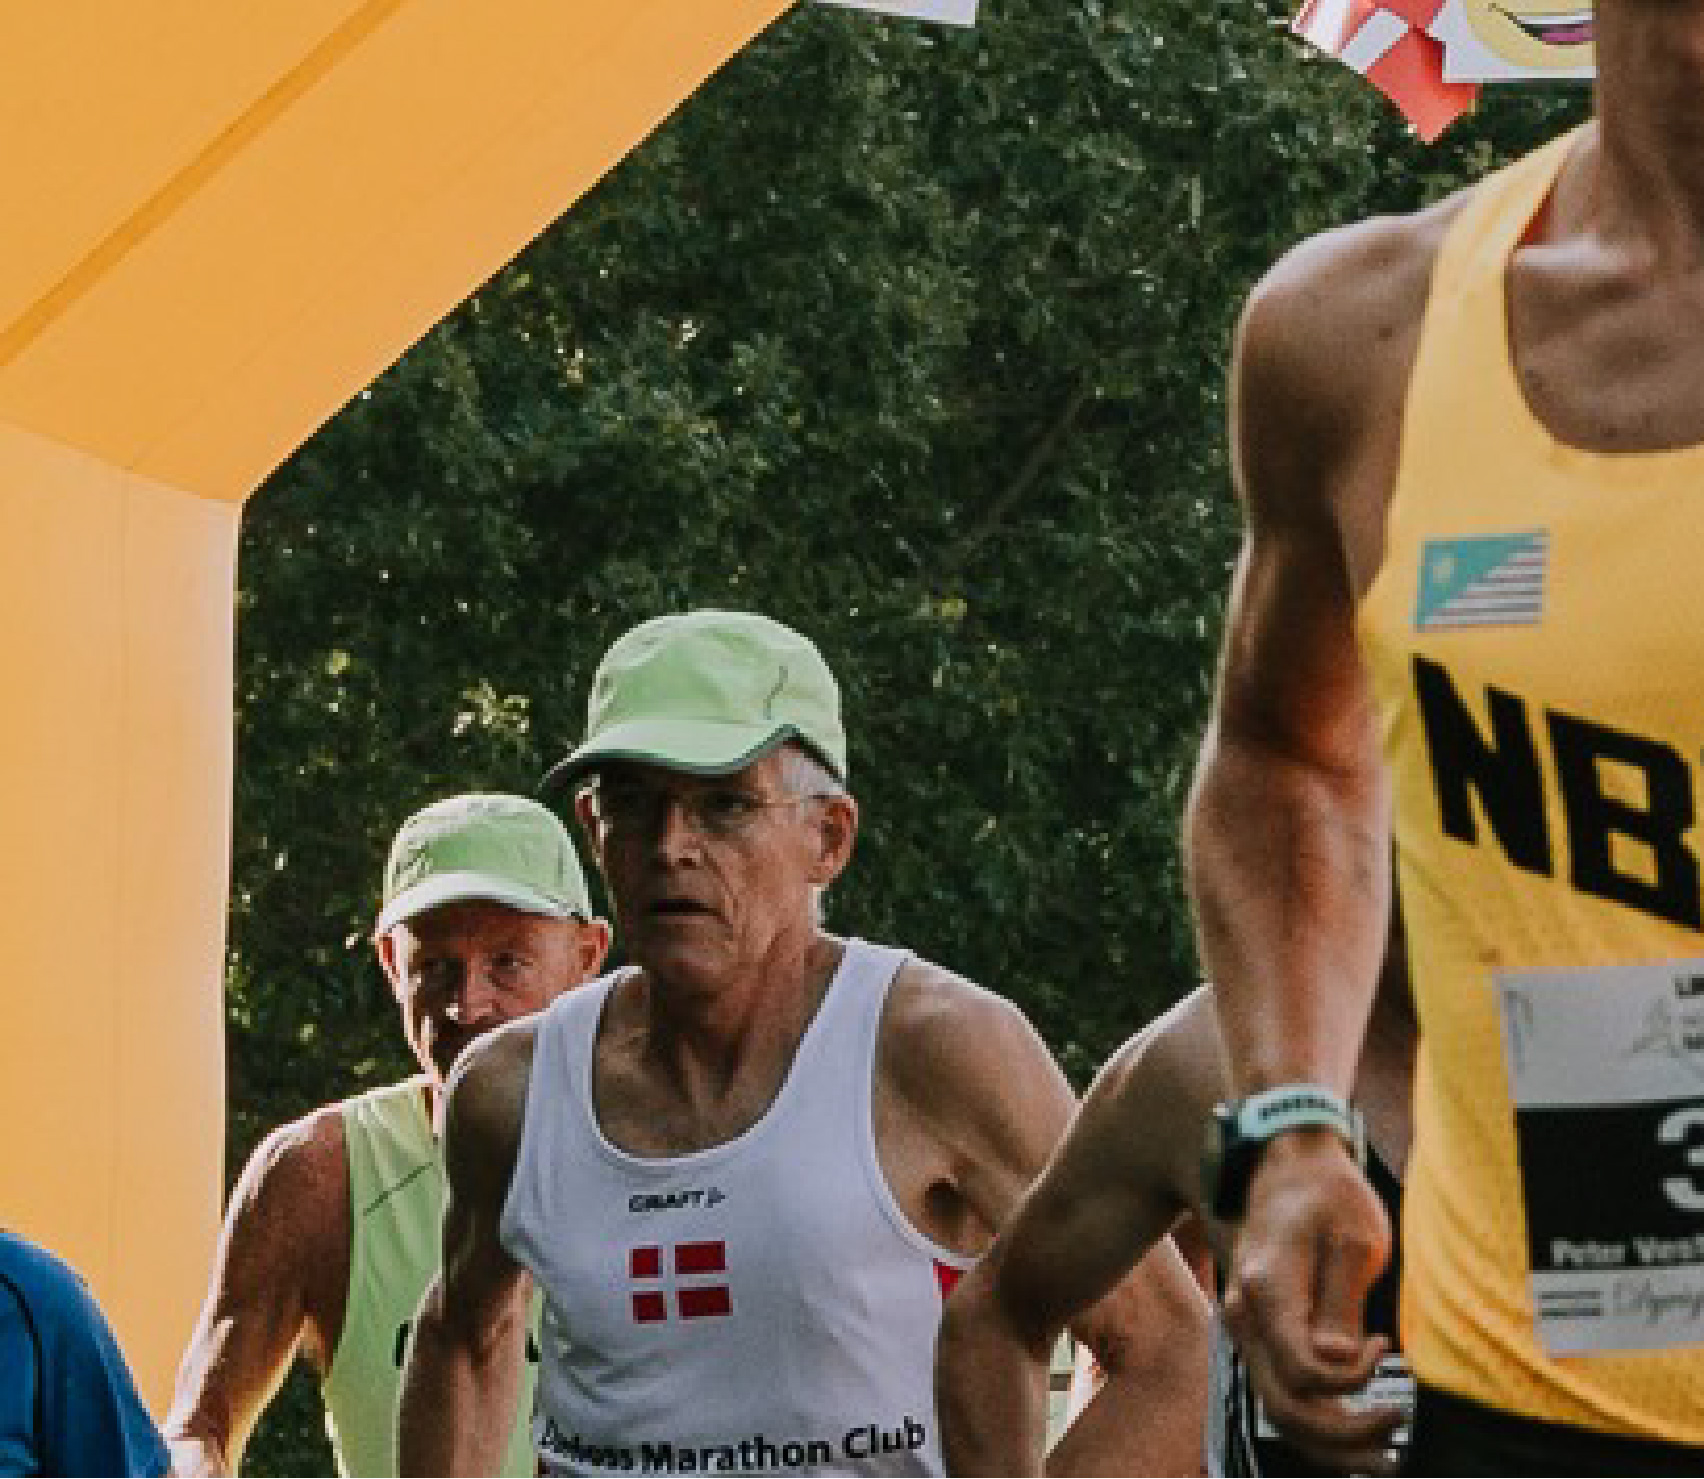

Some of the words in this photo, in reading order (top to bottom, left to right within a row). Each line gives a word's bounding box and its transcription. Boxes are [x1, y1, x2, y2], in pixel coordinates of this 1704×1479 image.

[1550, 1236, 1627, 1267] Peter
[641, 1433, 832, 1474] Marathon
[842, 1415, 927, 1460] Club
